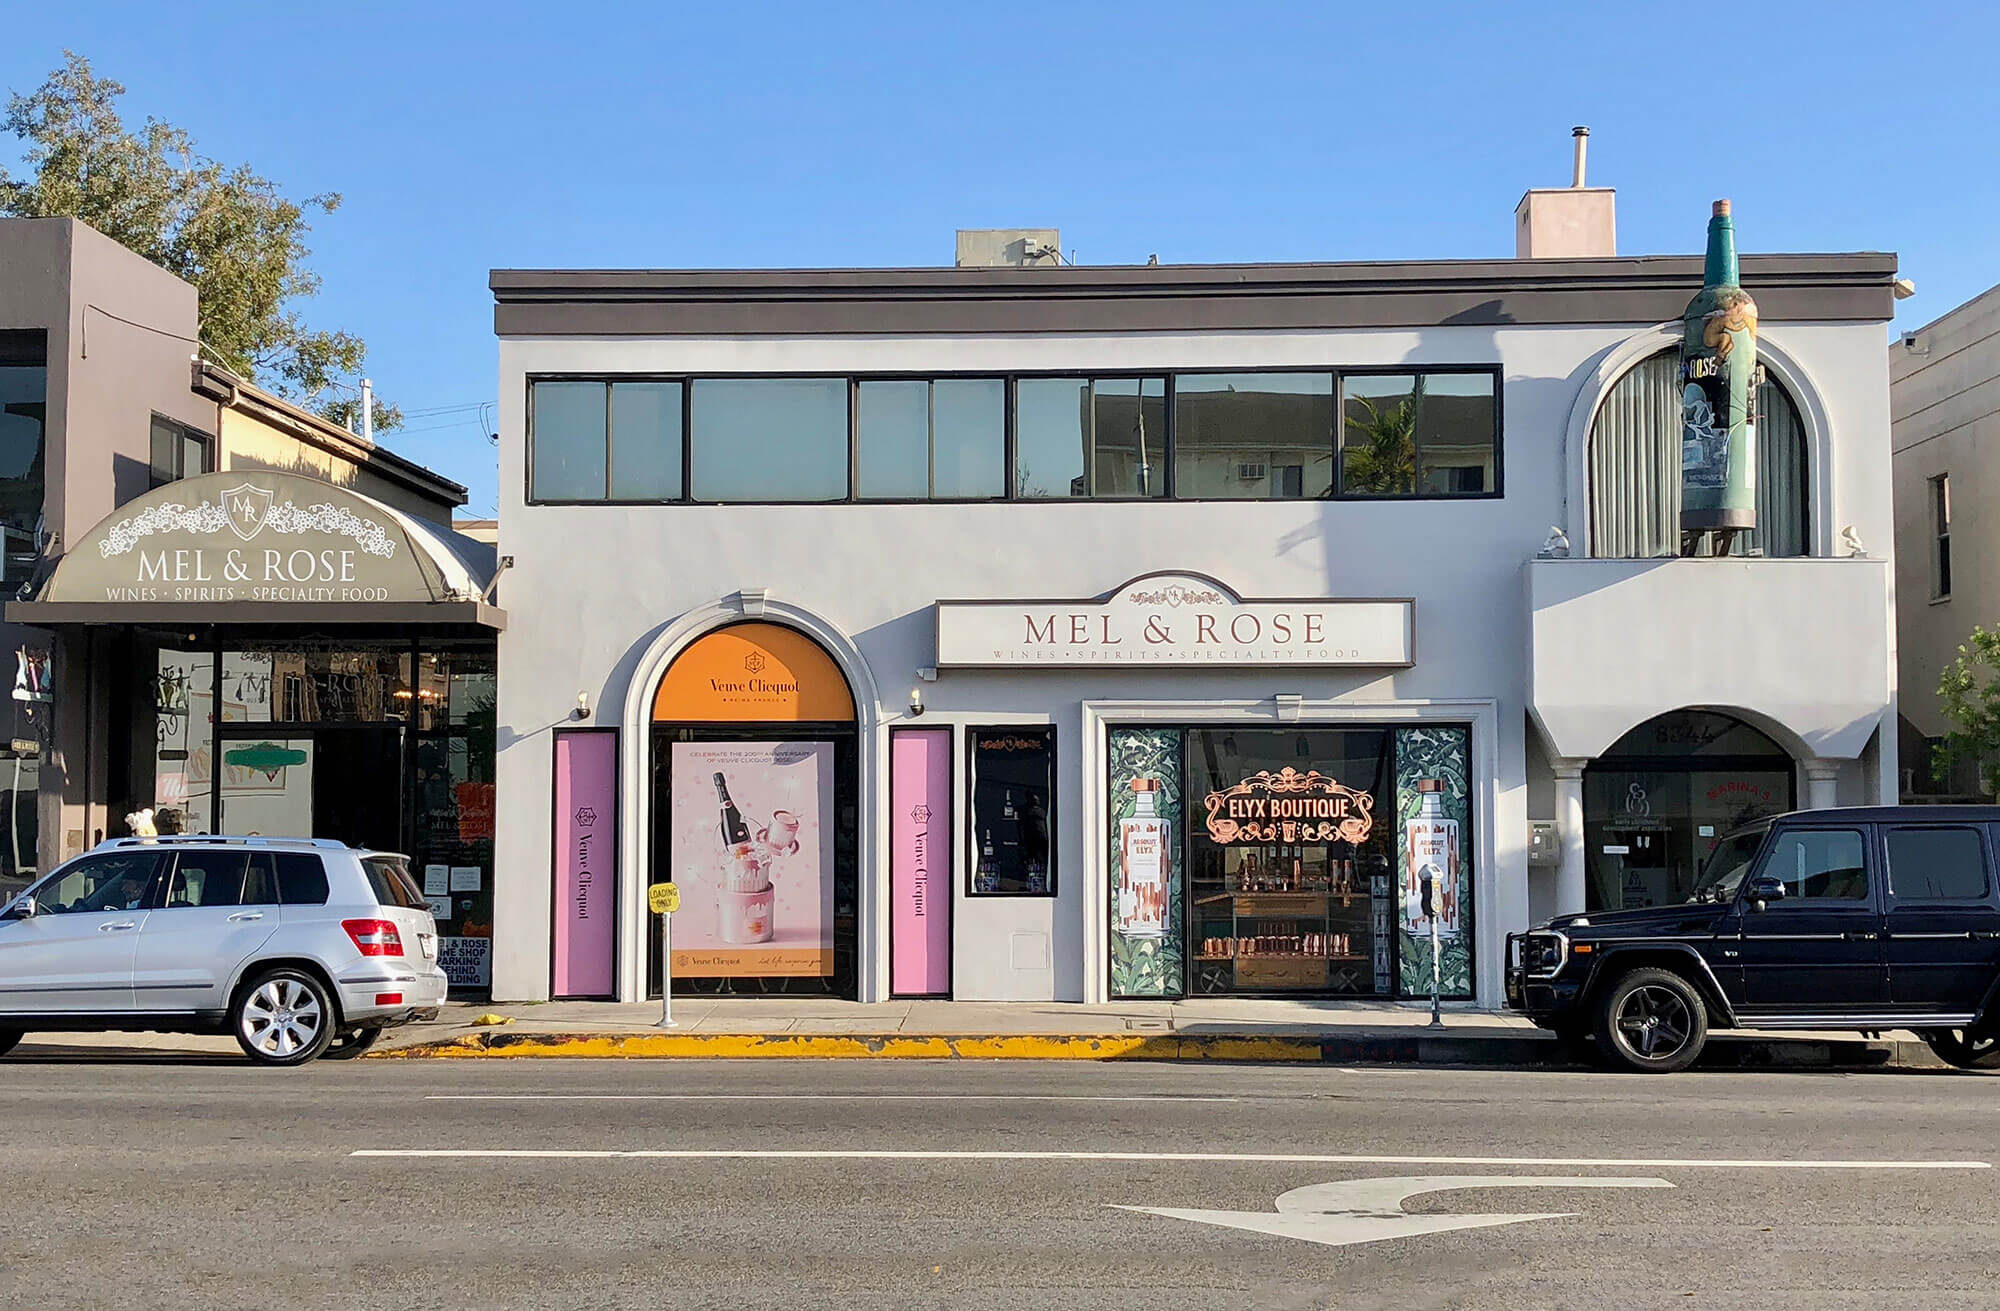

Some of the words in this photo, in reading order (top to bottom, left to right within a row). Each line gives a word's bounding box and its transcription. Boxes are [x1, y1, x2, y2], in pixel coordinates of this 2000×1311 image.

[137, 549, 212, 581] MEL
[223, 549, 252, 581] &
[263, 549, 356, 582] ROSE
[106, 587, 157, 600] WINES
[175, 587, 234, 600] SPIRITS
[252, 587, 335, 600] SPECIALTY
[342, 588, 389, 601] FOOD
[1023, 614, 1122, 644] MEL
[1143, 614, 1176, 644] &
[1195, 613, 1326, 644] ROSE
[993, 651, 1056, 659] WINES
[1078, 651, 1160, 659] SPIRITS
[1180, 650, 1294, 659] SPECIALTY
[1306, 650, 1359, 658] FOOD
[710, 679, 746, 693] Veuve
[748, 679, 800, 695] Clicquot
[1229, 800, 1265, 818] ELYX
[1271, 799, 1349, 818] BOUTIQUE
[580, 833, 593, 868] Veuve
[915, 831, 928, 865] Veuve
[576, 871, 593, 919] Clicquot
[651, 887, 677, 899] LOADING
[912, 868, 928, 916] Clicquot
[462, 940, 488, 948] ROSE
[439, 949, 456, 957] INE
[459, 949, 486, 957] SHOP
[437, 957, 480, 966] PARKING
[447, 975, 480, 983] ILDING
